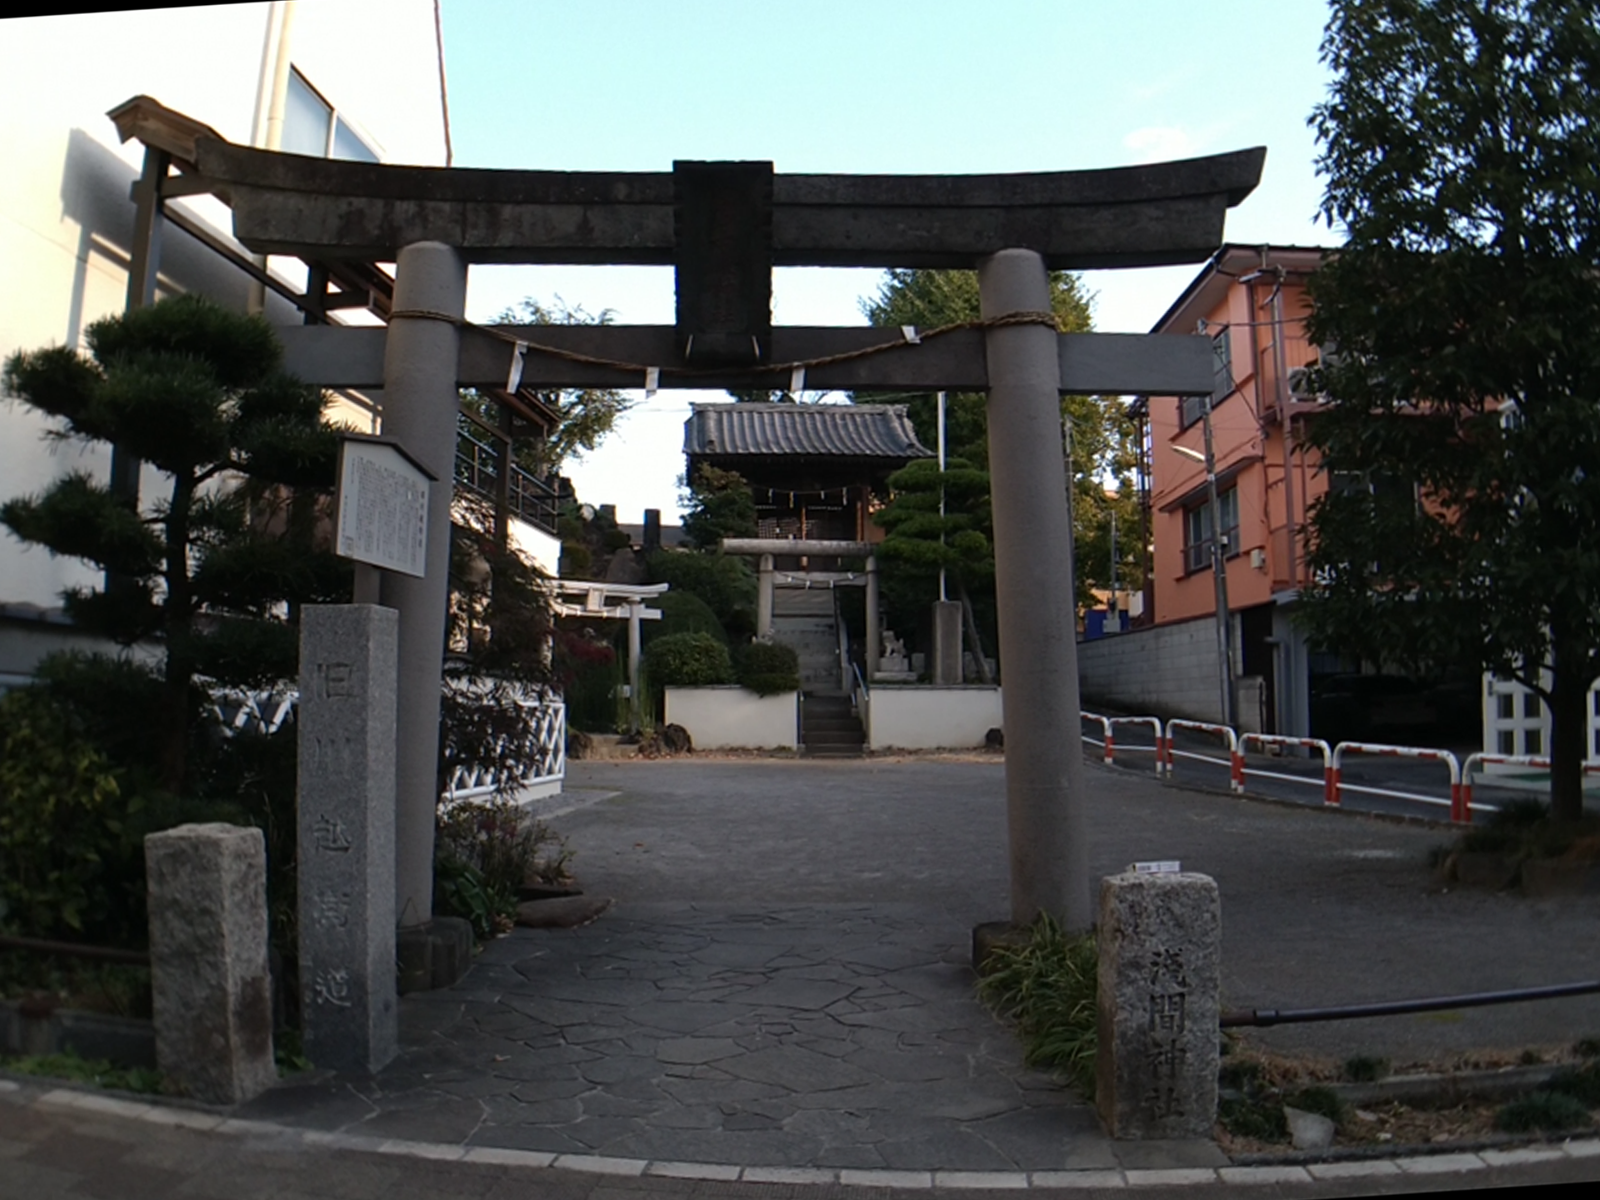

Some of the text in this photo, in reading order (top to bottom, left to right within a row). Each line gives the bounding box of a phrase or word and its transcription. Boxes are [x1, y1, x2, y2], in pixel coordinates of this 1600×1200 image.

[312, 661, 352, 1008] 旧川越街道
